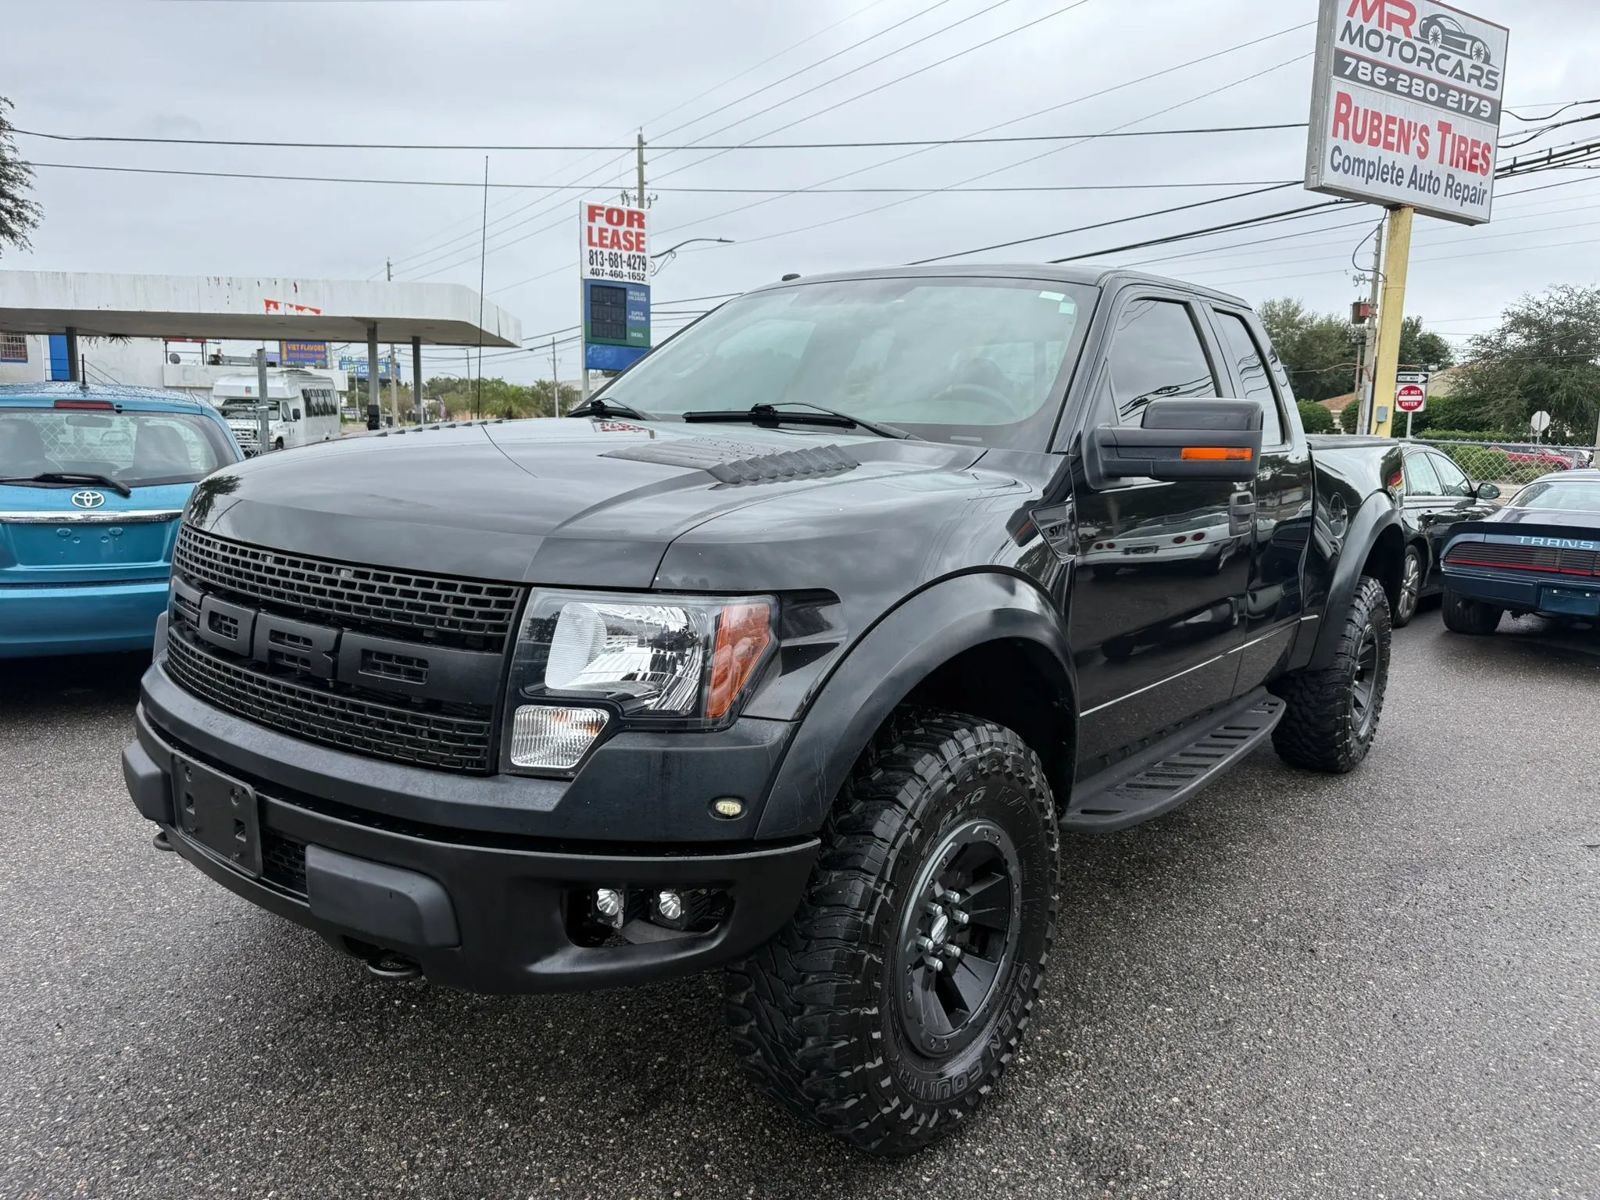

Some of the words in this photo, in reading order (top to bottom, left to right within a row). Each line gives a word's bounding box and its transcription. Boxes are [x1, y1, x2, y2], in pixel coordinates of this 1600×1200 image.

[1346, 0, 1417, 39] MR
[1339, 20, 1499, 91] MOTORCARS
[1343, 57, 1492, 118] 786-280-2179
[1331, 91, 1430, 160] RUBEN'S
[1437, 121, 1492, 177] TIRES
[1330, 145, 1404, 186] Complete
[1407, 165, 1441, 195] Auto
[1444, 173, 1487, 206] Repair
[587, 205, 645, 229] FOR
[587, 226, 646, 253] LEASE
[589, 249, 646, 271] 813-681-4279
[590, 268, 646, 282] 407-460-1652
[1515, 535, 1594, 549] TRANS
[168, 574, 503, 702] FORD
